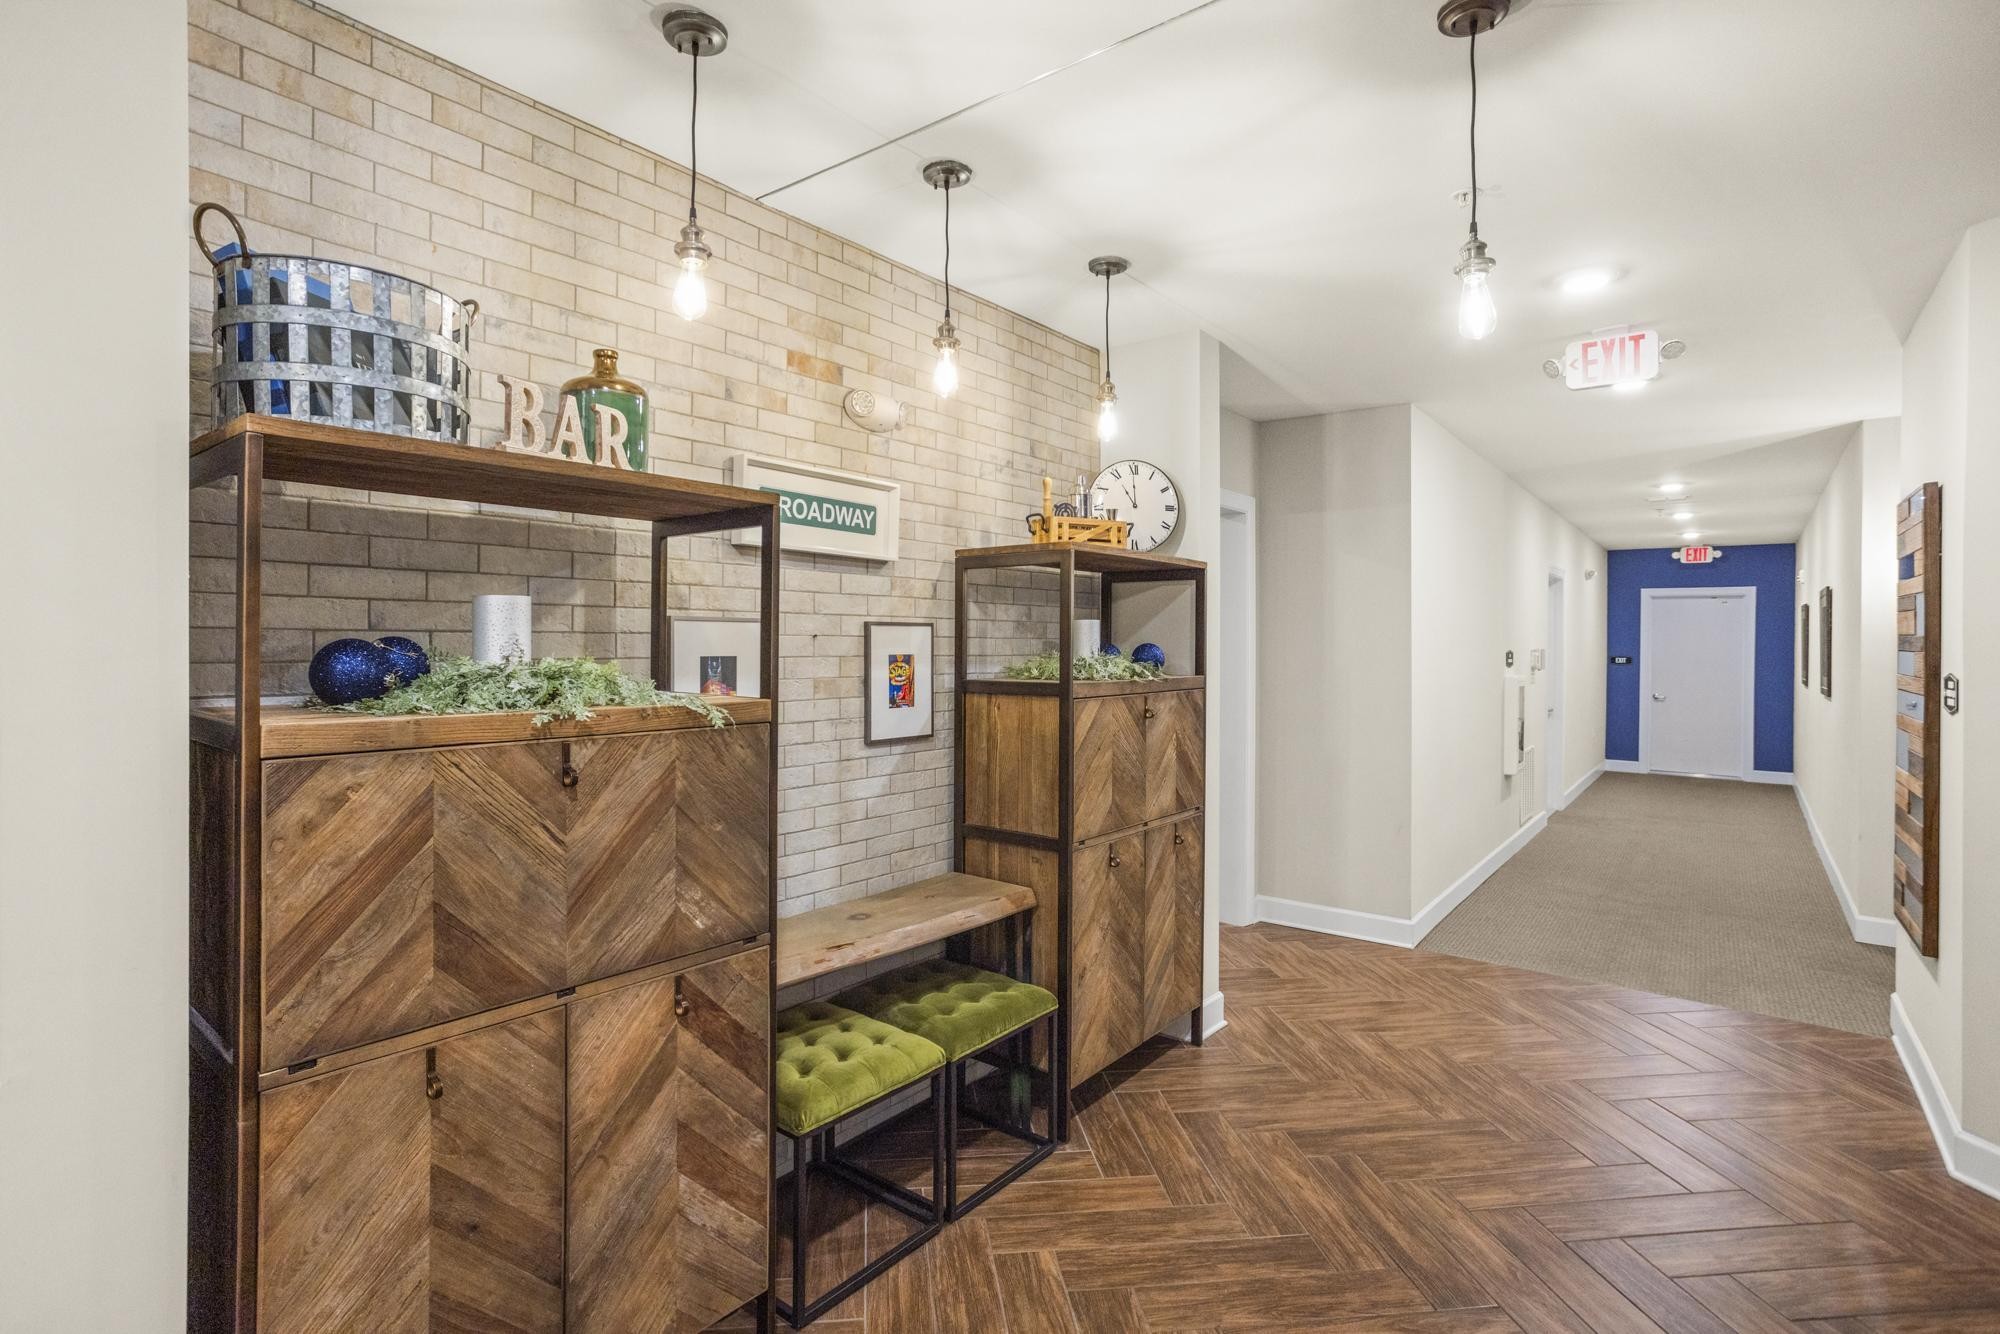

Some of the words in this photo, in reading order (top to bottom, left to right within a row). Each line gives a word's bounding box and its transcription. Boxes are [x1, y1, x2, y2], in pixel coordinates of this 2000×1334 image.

[1581, 333, 1646, 383] EXIT
[497, 374, 634, 471] BAR
[779, 496, 875, 529] ROADWAY
[1685, 547, 1709, 562] EXIT
